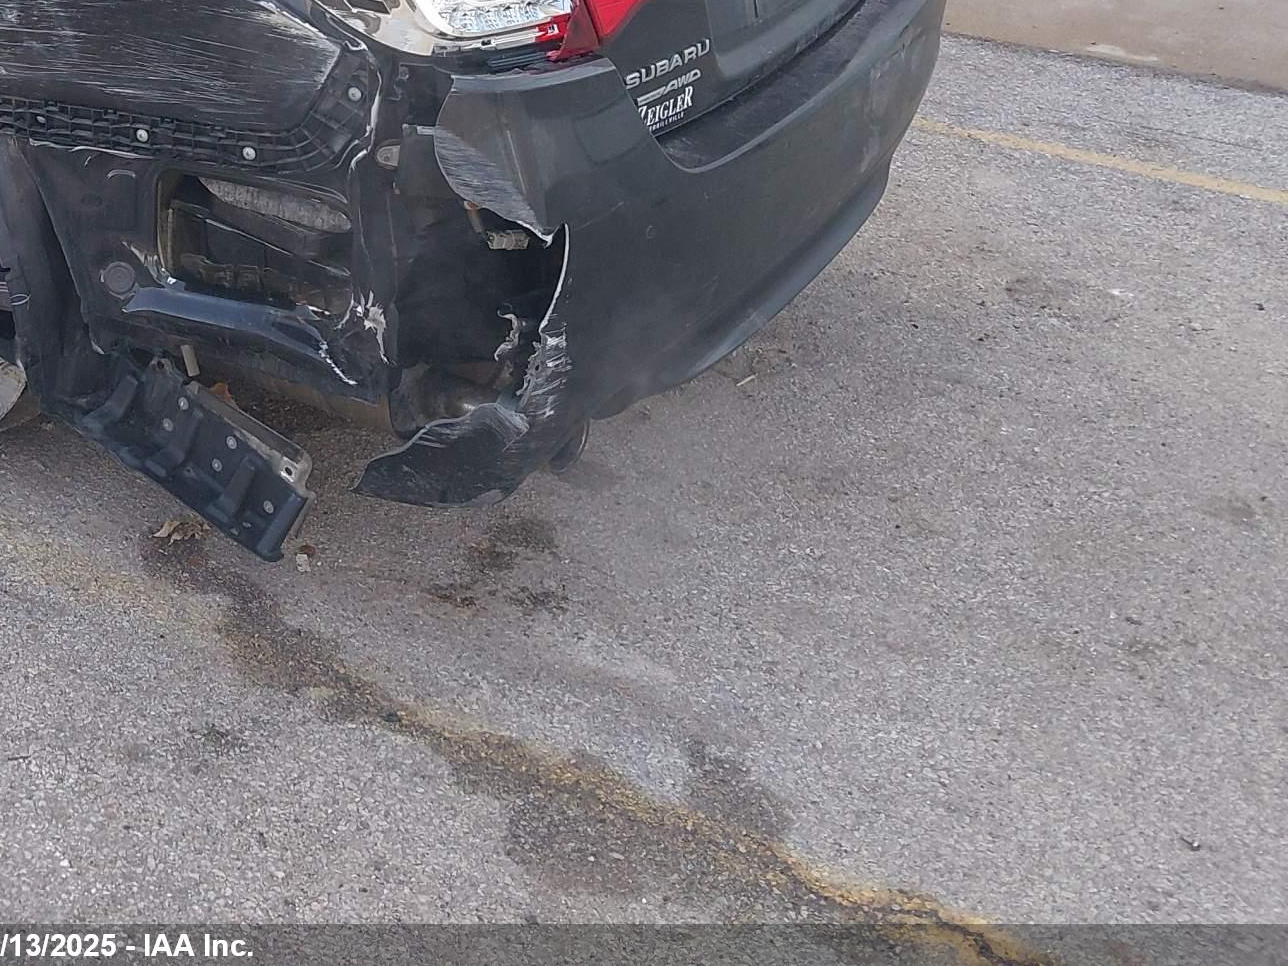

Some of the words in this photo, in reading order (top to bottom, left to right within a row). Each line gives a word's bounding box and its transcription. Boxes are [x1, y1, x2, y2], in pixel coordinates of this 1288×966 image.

[625, 38, 710, 90] SUBARU
[663, 68, 701, 95] AWD
[638, 85, 693, 126] ZEIGLER
